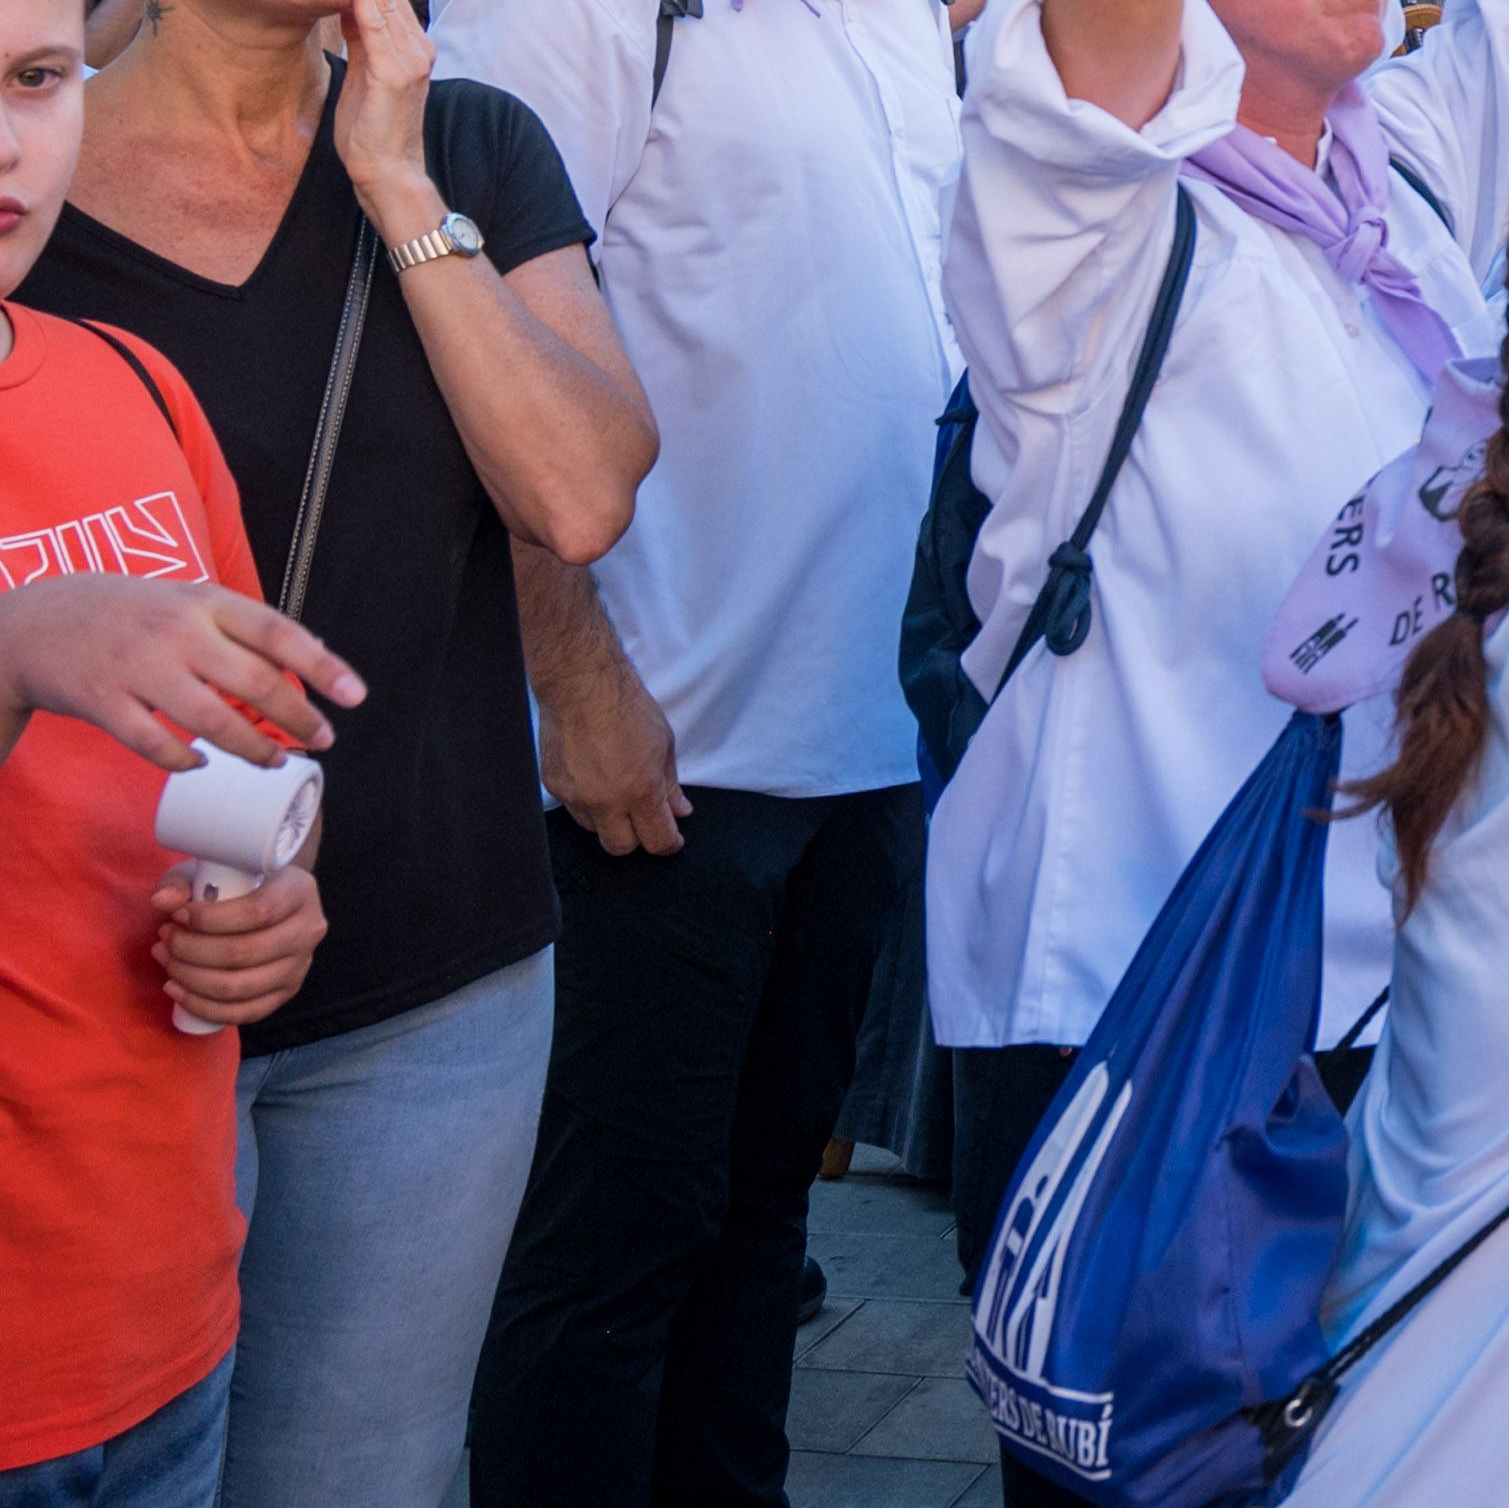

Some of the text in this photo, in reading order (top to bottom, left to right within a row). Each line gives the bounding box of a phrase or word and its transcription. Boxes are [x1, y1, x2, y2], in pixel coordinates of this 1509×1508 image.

[1389, 595, 1424, 647] DE
[1018, 1394, 1048, 1445] DE
[1045, 1403, 1114, 1469] RUBÍ
